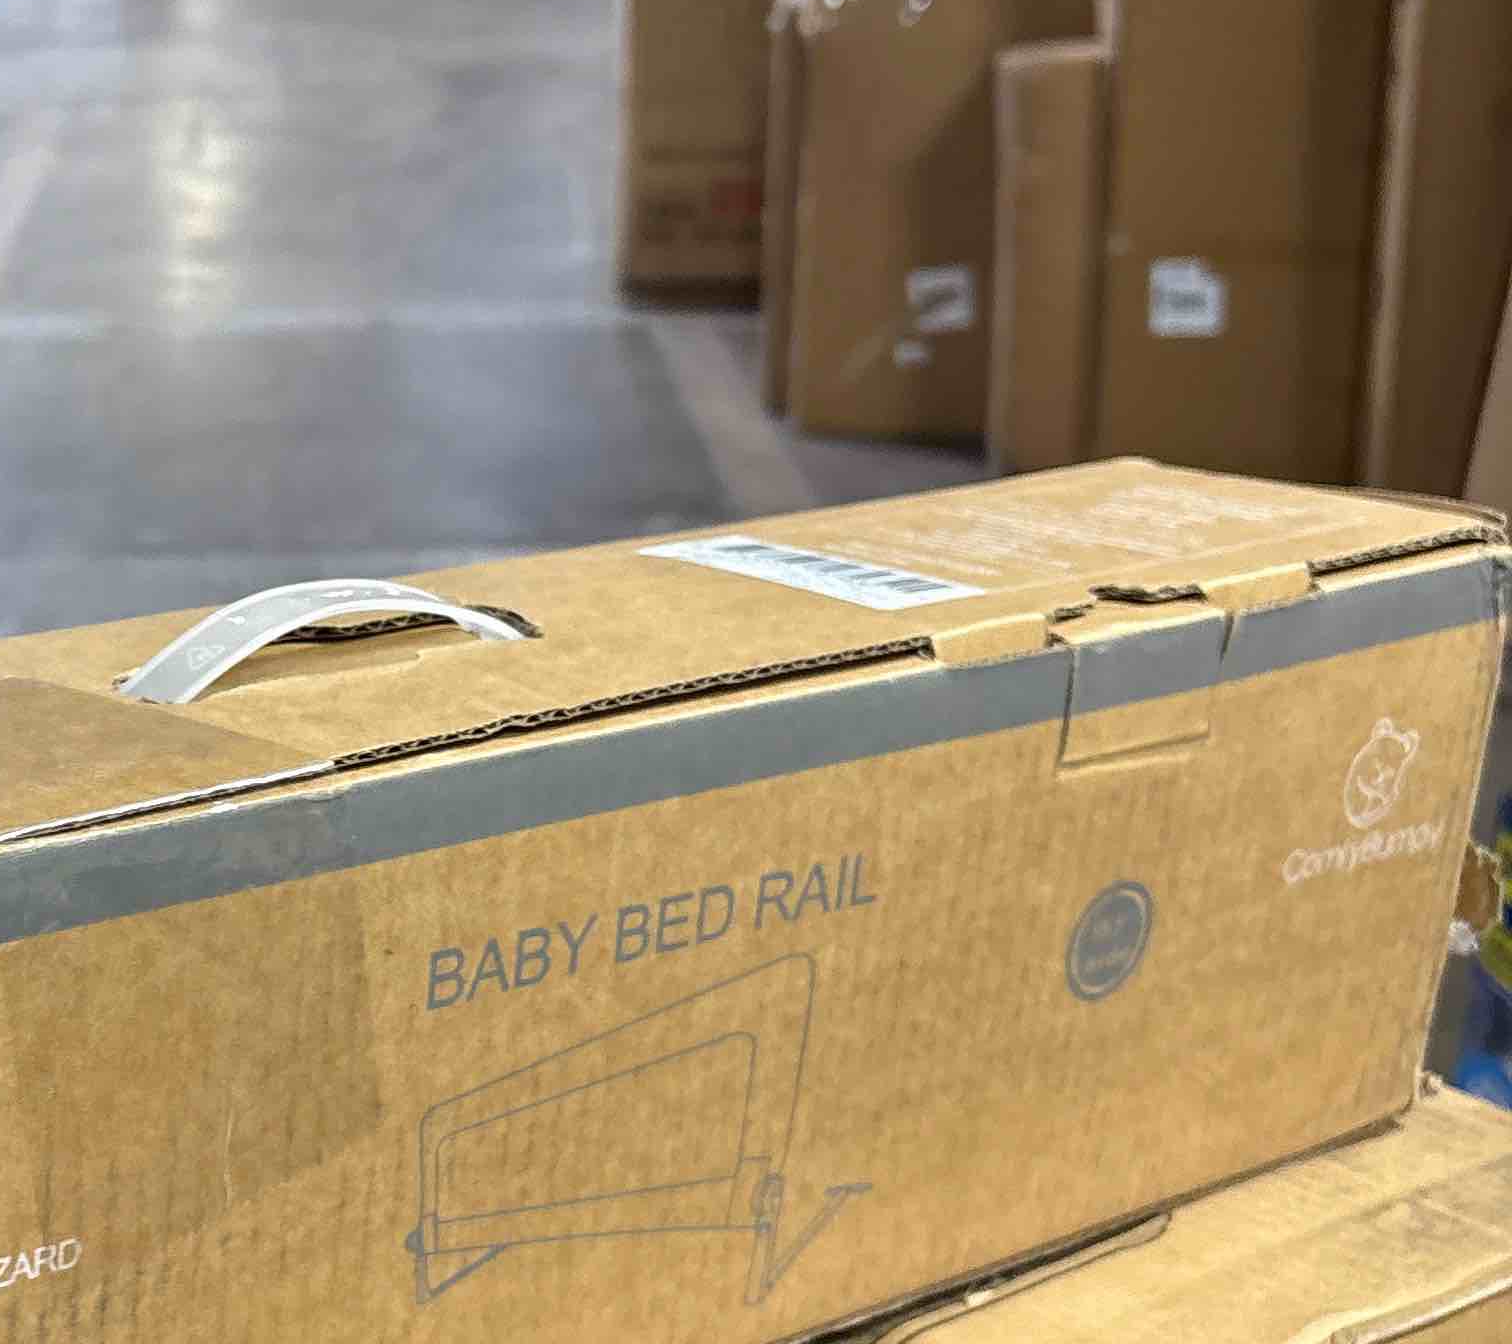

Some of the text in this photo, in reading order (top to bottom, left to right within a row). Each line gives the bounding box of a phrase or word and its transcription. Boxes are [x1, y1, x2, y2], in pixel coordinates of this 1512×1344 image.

[423, 854, 878, 1011] BABY BED RAIL
